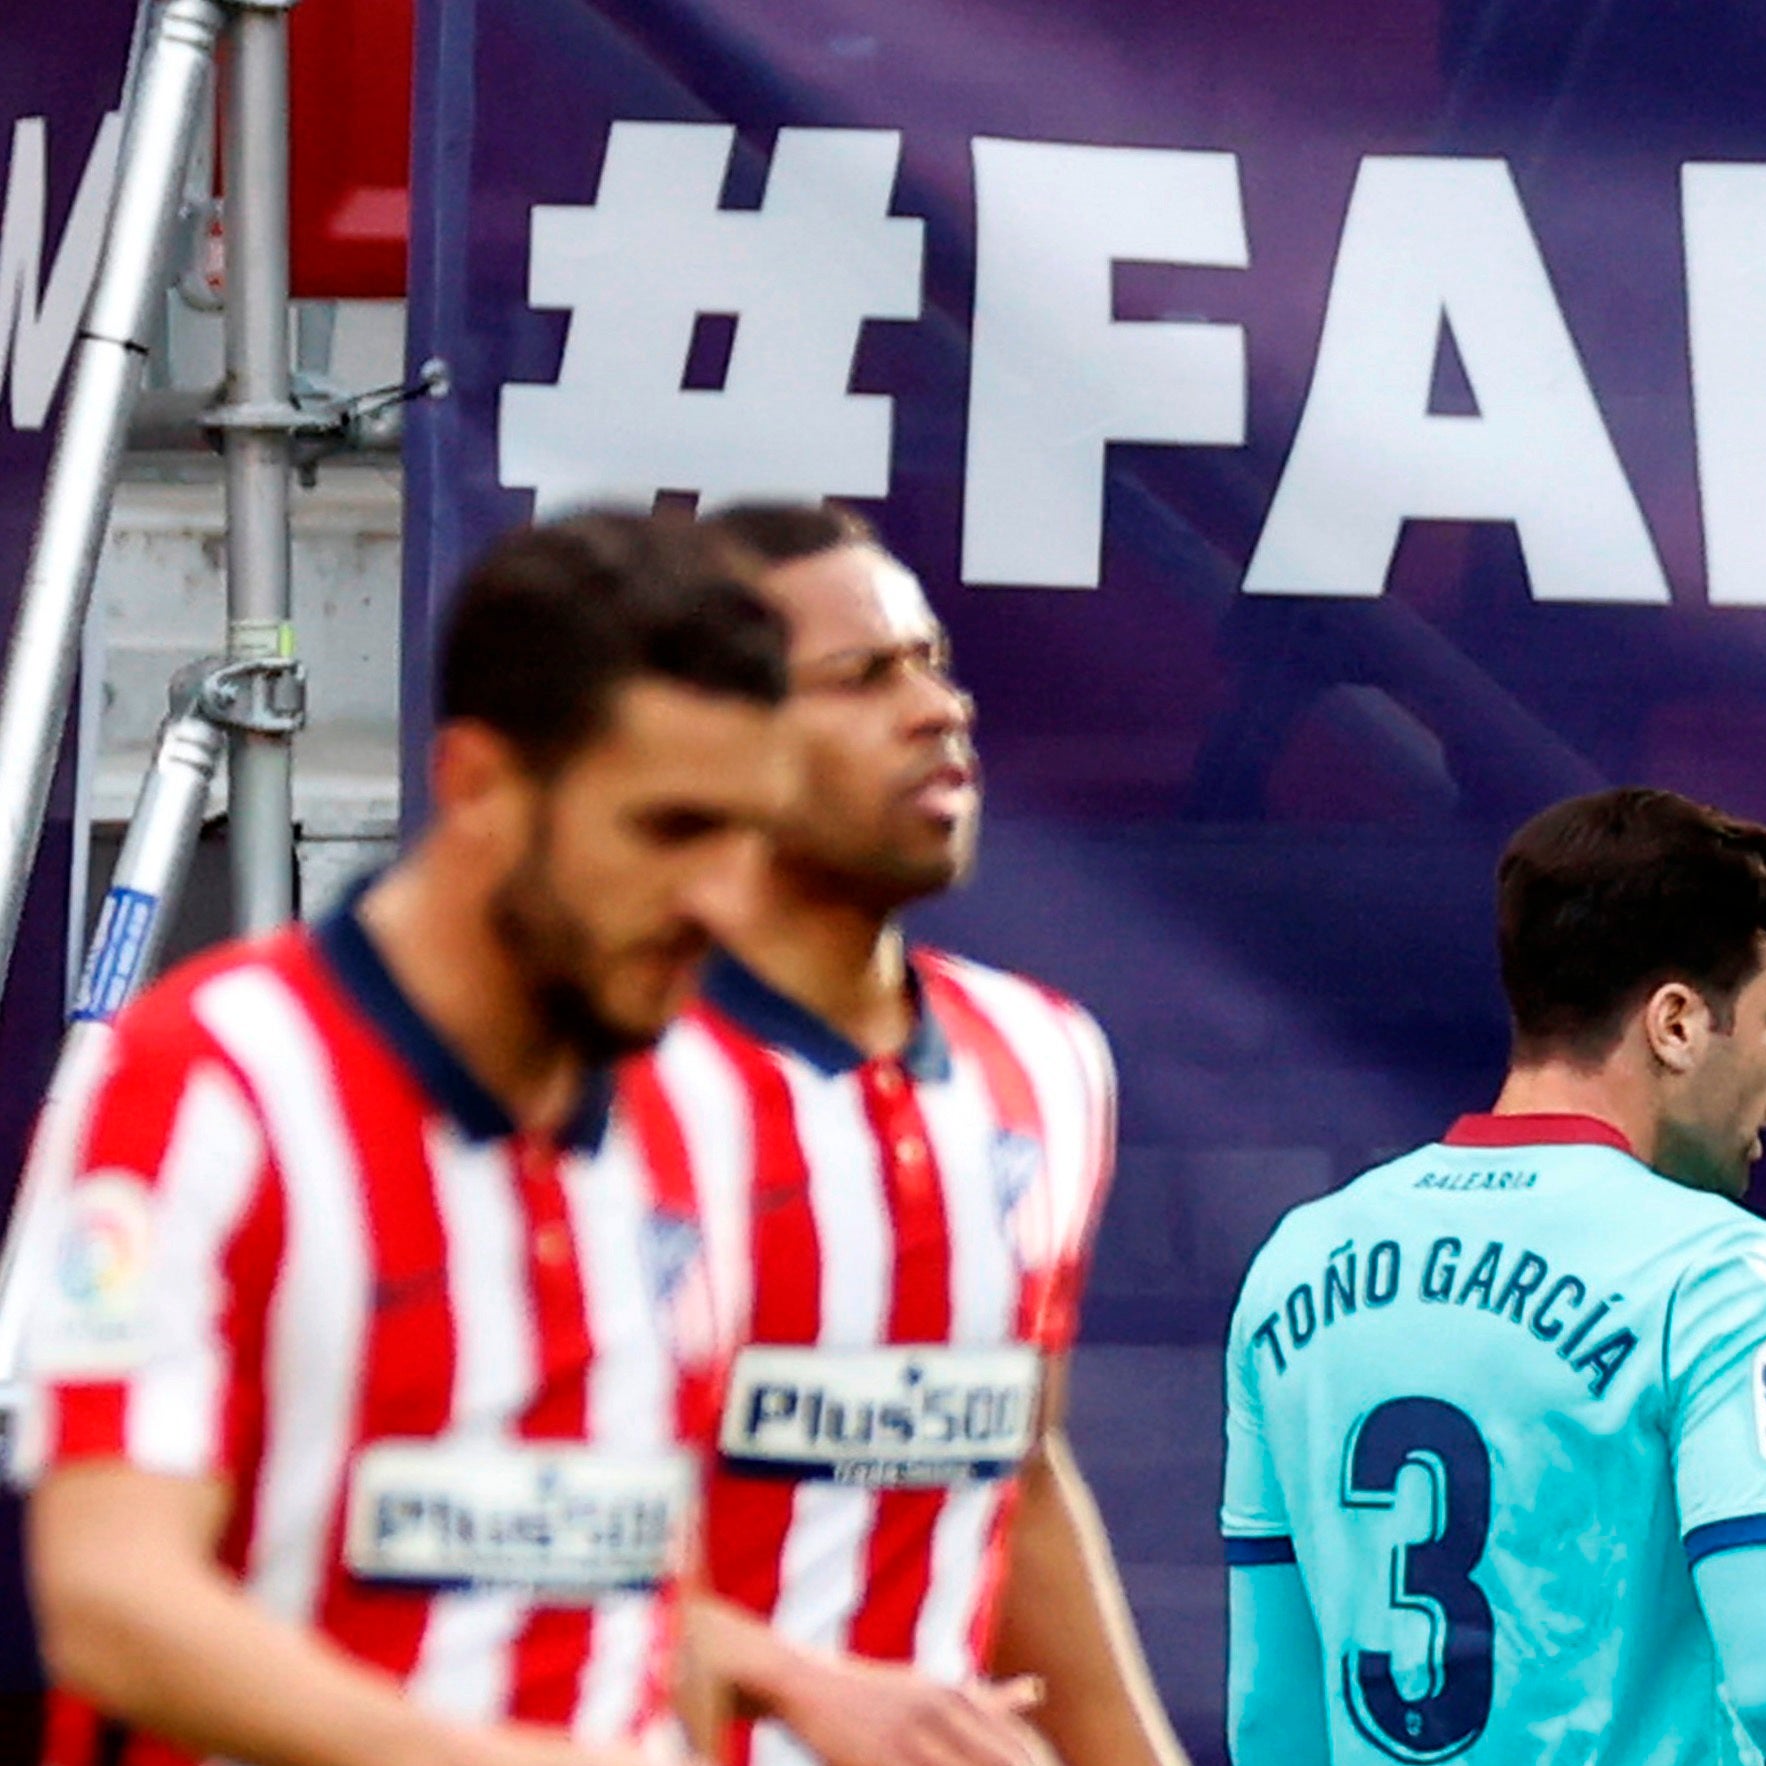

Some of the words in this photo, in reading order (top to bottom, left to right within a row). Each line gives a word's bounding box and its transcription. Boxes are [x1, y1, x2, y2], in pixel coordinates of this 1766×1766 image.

[1251, 1238, 1402, 1376] TOÑO
[1419, 1236, 1640, 1400] GARCÍA
[1340, 1396, 1495, 1765] 3
